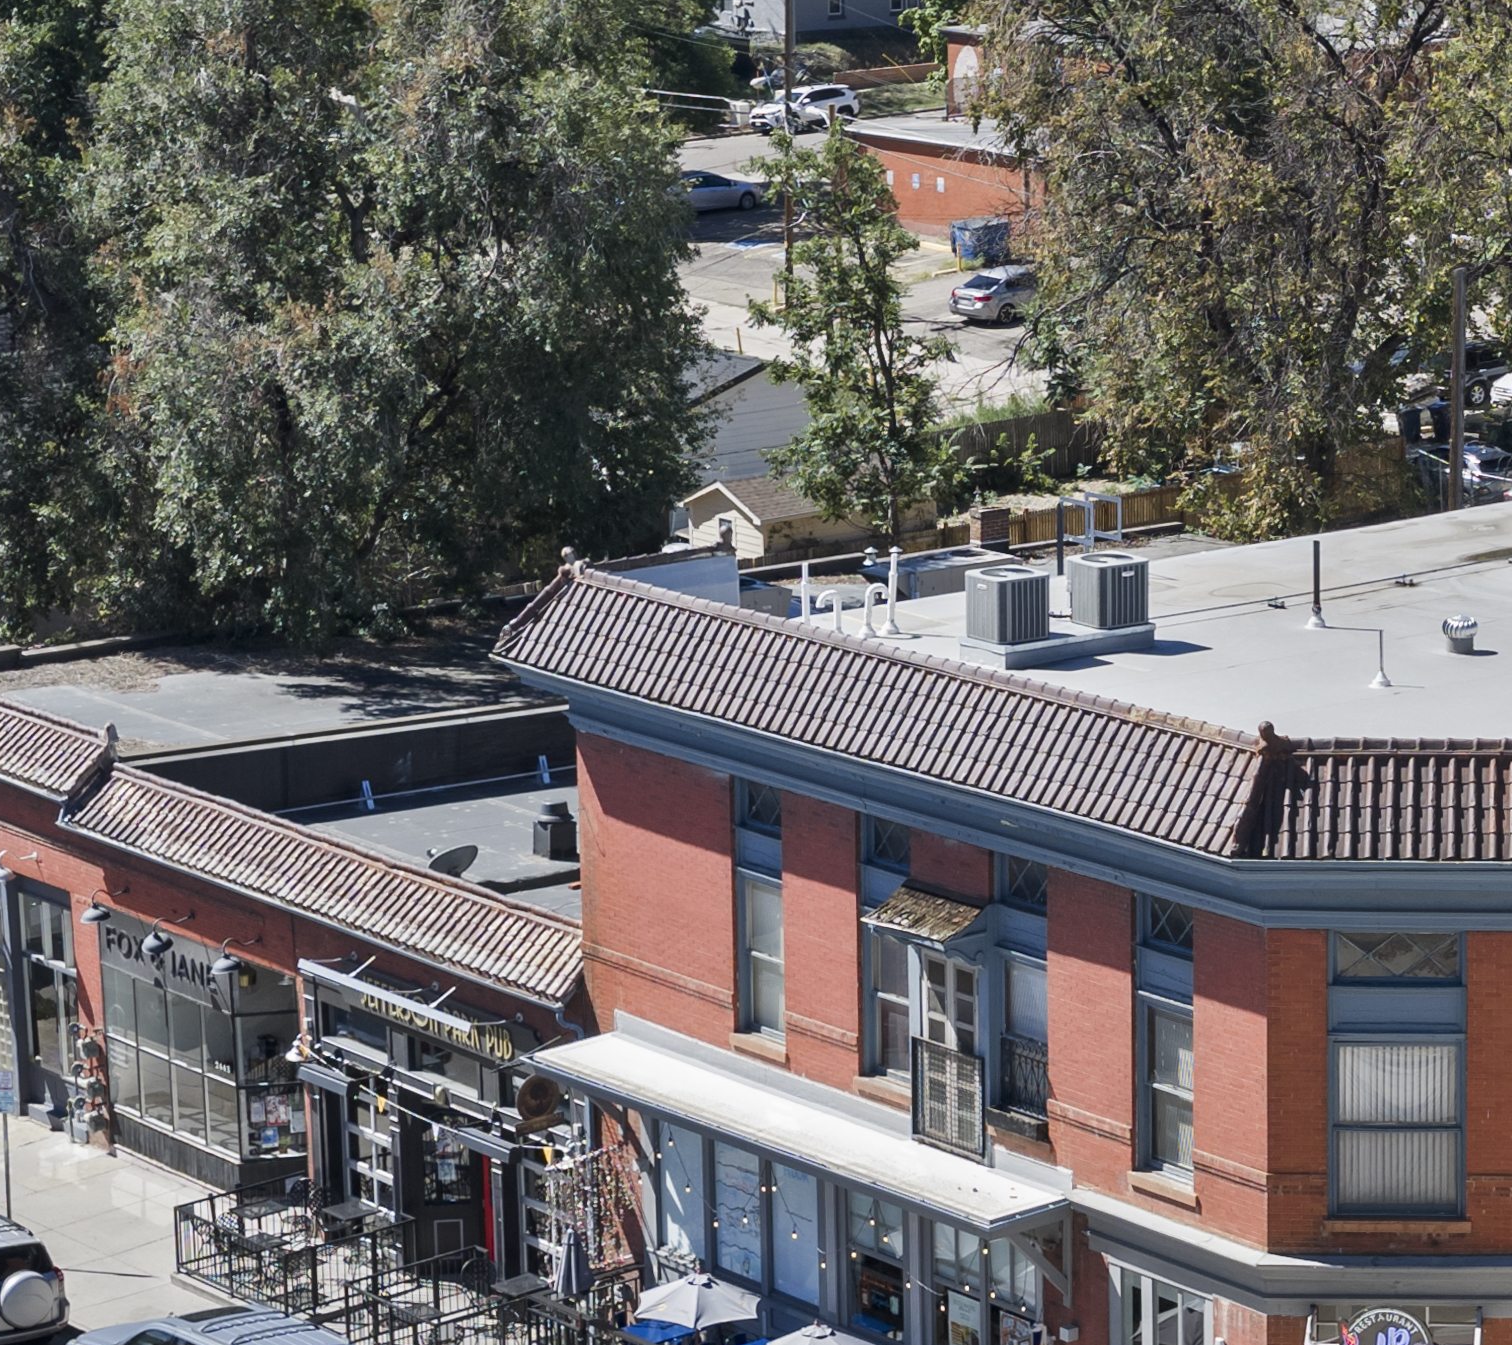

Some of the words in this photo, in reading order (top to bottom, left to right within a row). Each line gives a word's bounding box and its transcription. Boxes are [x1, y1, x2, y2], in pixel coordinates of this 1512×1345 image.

[106, 924, 146, 965] FOX
[444, 1006, 481, 1050] PARK
[485, 1024, 513, 1060] PUB
[1354, 1313, 1419, 1335] RESTAURANT
